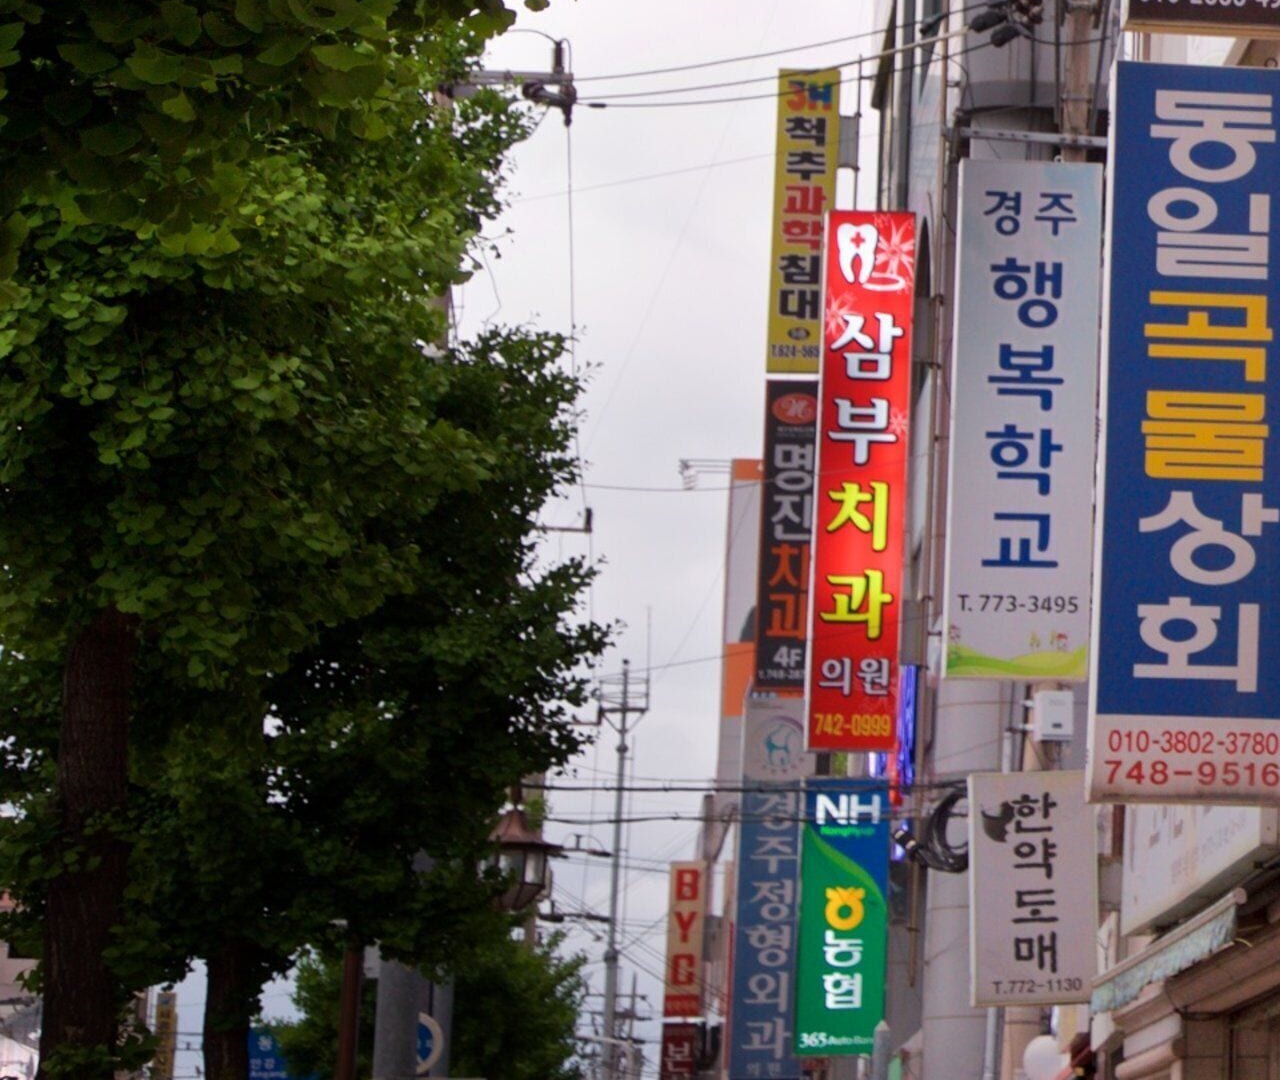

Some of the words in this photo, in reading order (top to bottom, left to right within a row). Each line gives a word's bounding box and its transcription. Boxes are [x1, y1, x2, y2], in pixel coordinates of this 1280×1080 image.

[982, 189, 1077, 237] 경주
[981, 257, 1065, 569] 행복학교
[979, 594, 1079, 615] 773-3495
[819, 657, 889, 698] 의원
[814, 713, 892, 736] 742-0999
[1108, 730, 1279, 755] 010-3802-3780
[1104, 760, 1280, 787] 748-9516
[816, 793, 881, 825] NH
[1012, 792, 1059, 973] 한약도매
[822, 930, 863, 1010] 농협
